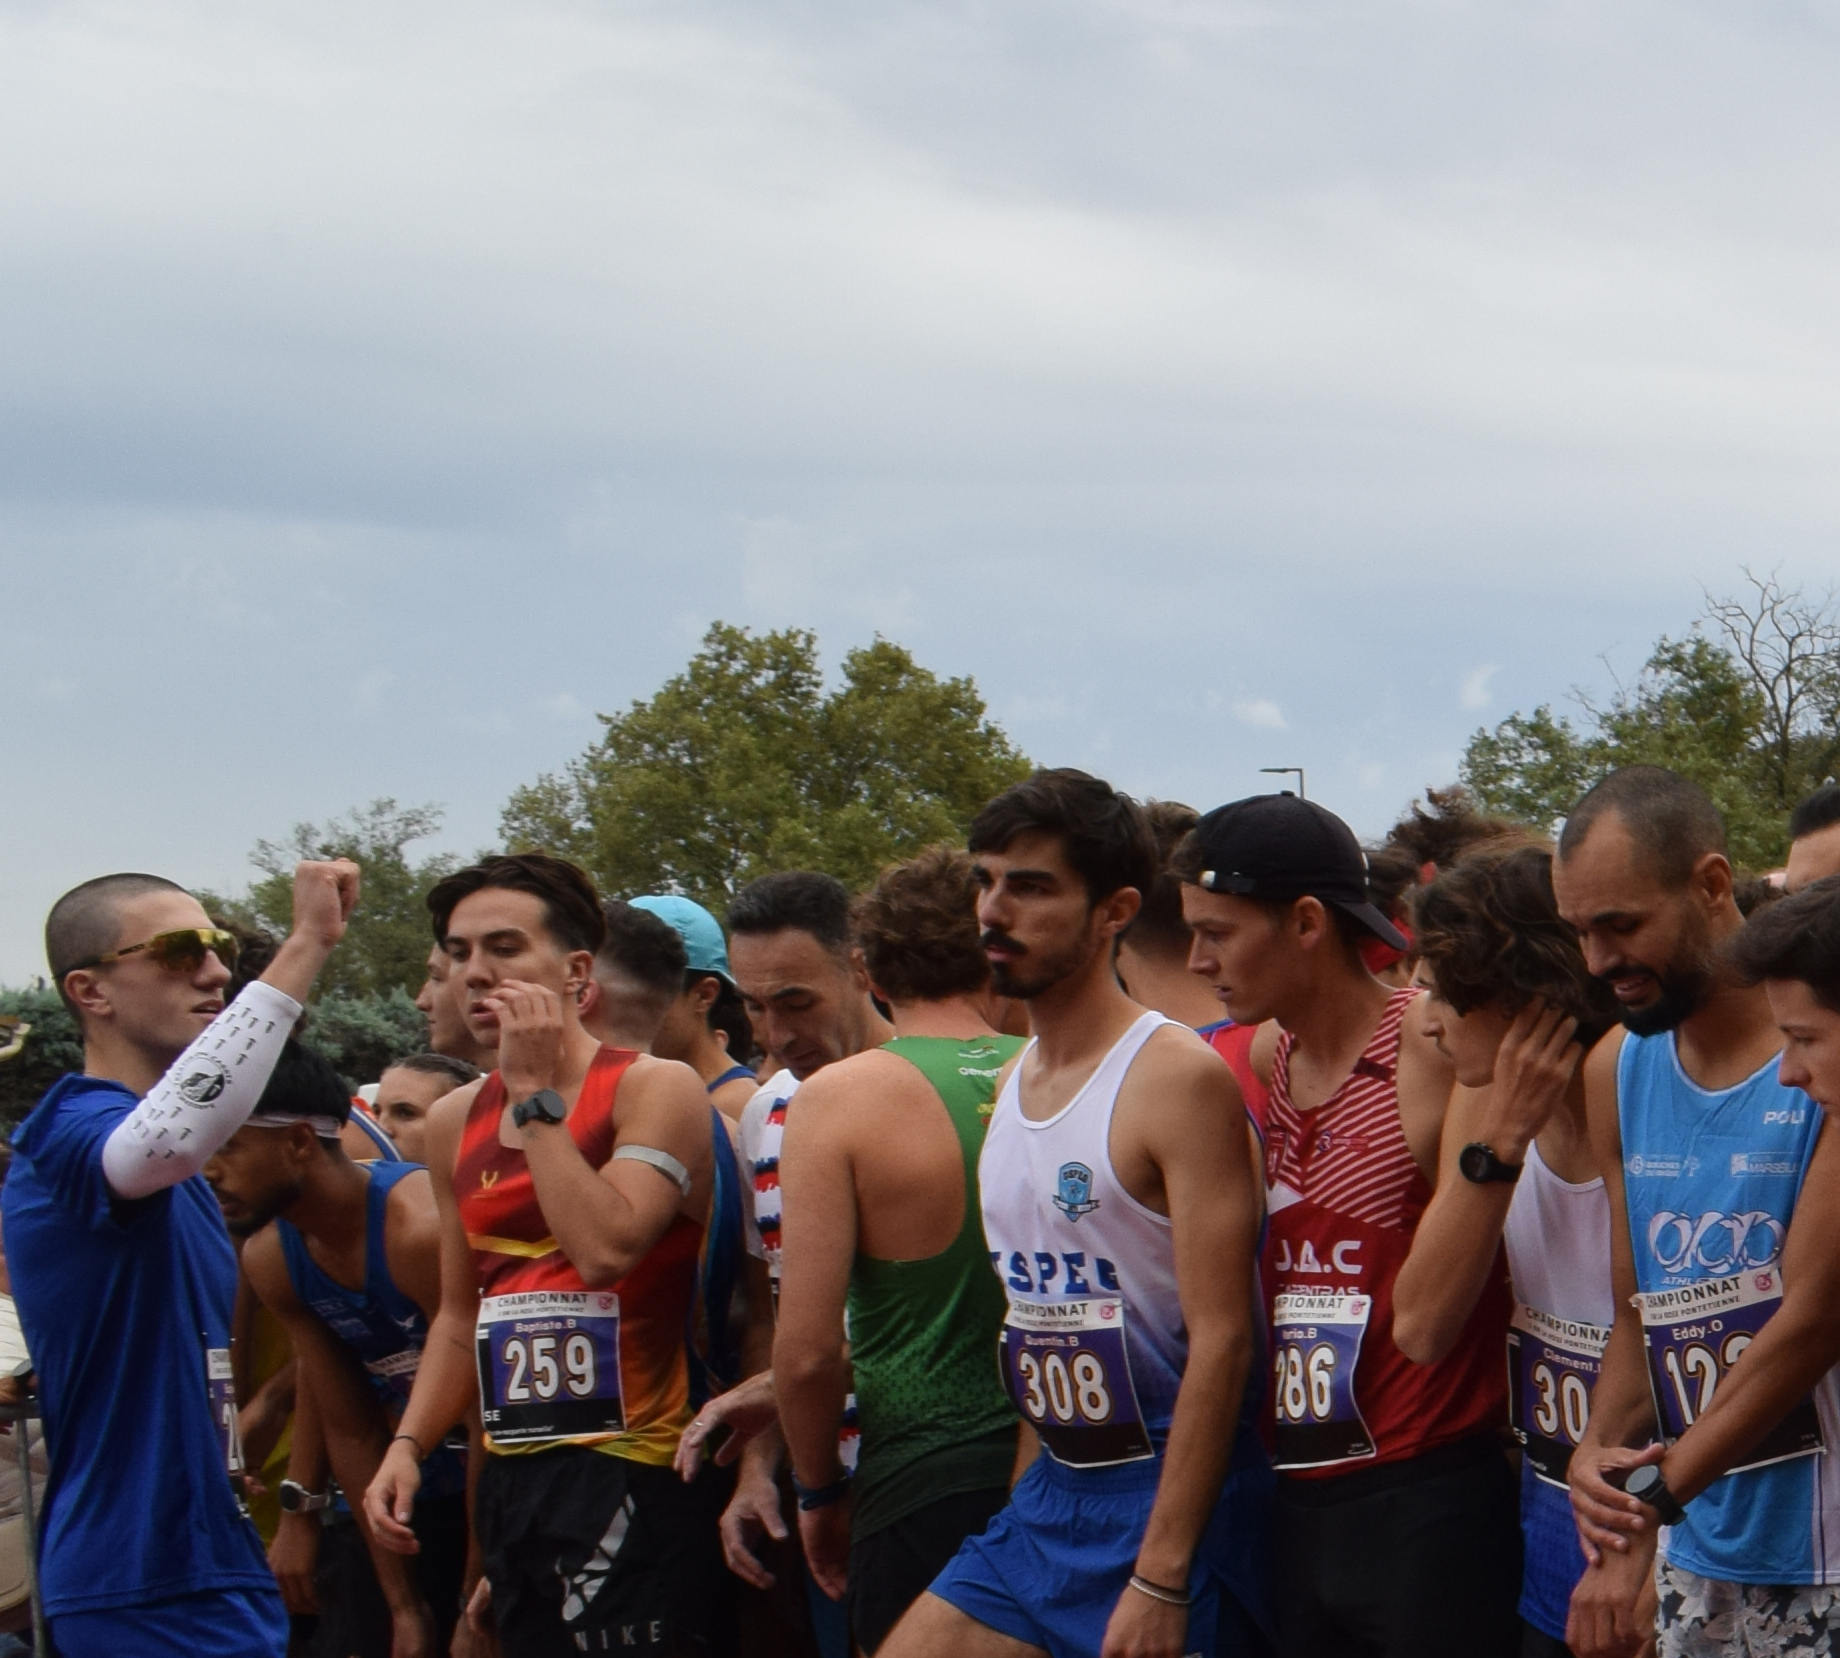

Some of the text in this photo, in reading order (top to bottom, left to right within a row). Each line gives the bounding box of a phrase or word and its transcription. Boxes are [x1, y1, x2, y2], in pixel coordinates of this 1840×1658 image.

[1763, 1110, 1805, 1124] POLI
[991, 1251, 1122, 1294] SPEG
[497, 1293, 588, 1308] CHAMPIONNAT
[515, 1318, 577, 1334] Baptiste.B
[1526, 1307, 1612, 1343] CHAMPIONNA
[1672, 1319, 1723, 1341] Eddy.O
[504, 1334, 596, 1401] 259
[1543, 1348, 1602, 1373] Clement.
[1019, 1351, 1111, 1422] 308
[1664, 1334, 1754, 1427] 12
[484, 1410, 501, 1422] SE
[574, 1620, 661, 1651] NIKE
